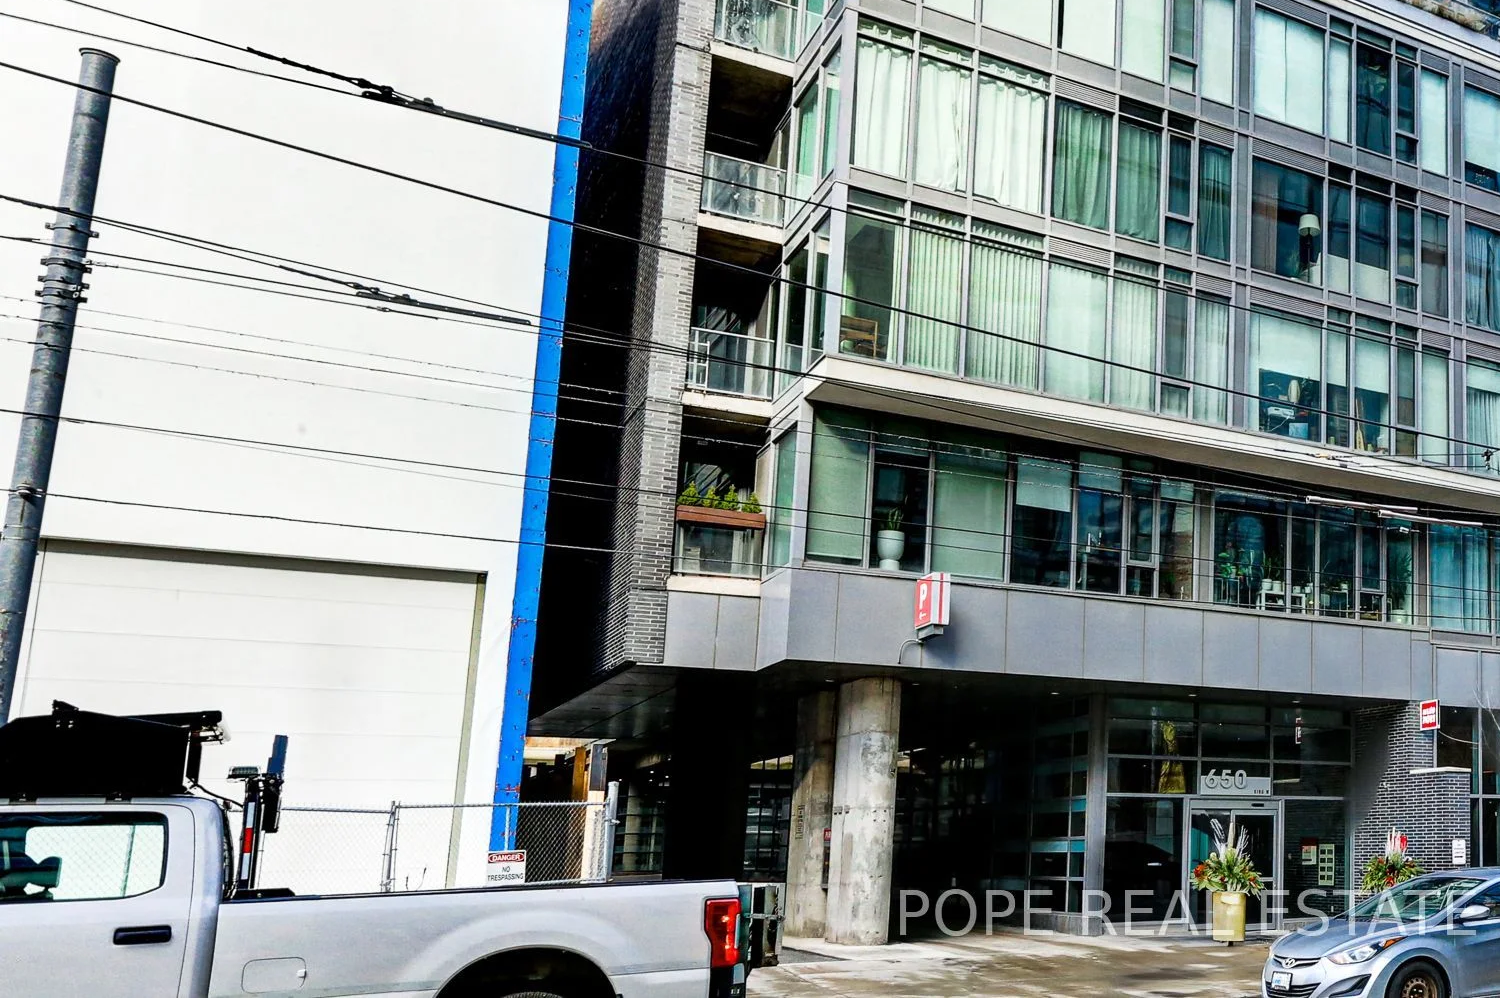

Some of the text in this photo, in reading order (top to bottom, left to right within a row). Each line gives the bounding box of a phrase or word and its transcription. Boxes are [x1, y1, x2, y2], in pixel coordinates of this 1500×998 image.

[919, 583, 928, 610] P
[1205, 769, 1247, 789] 650
[492, 853, 521, 861] DANGER
[487, 873, 524, 881] TRESPASSING
